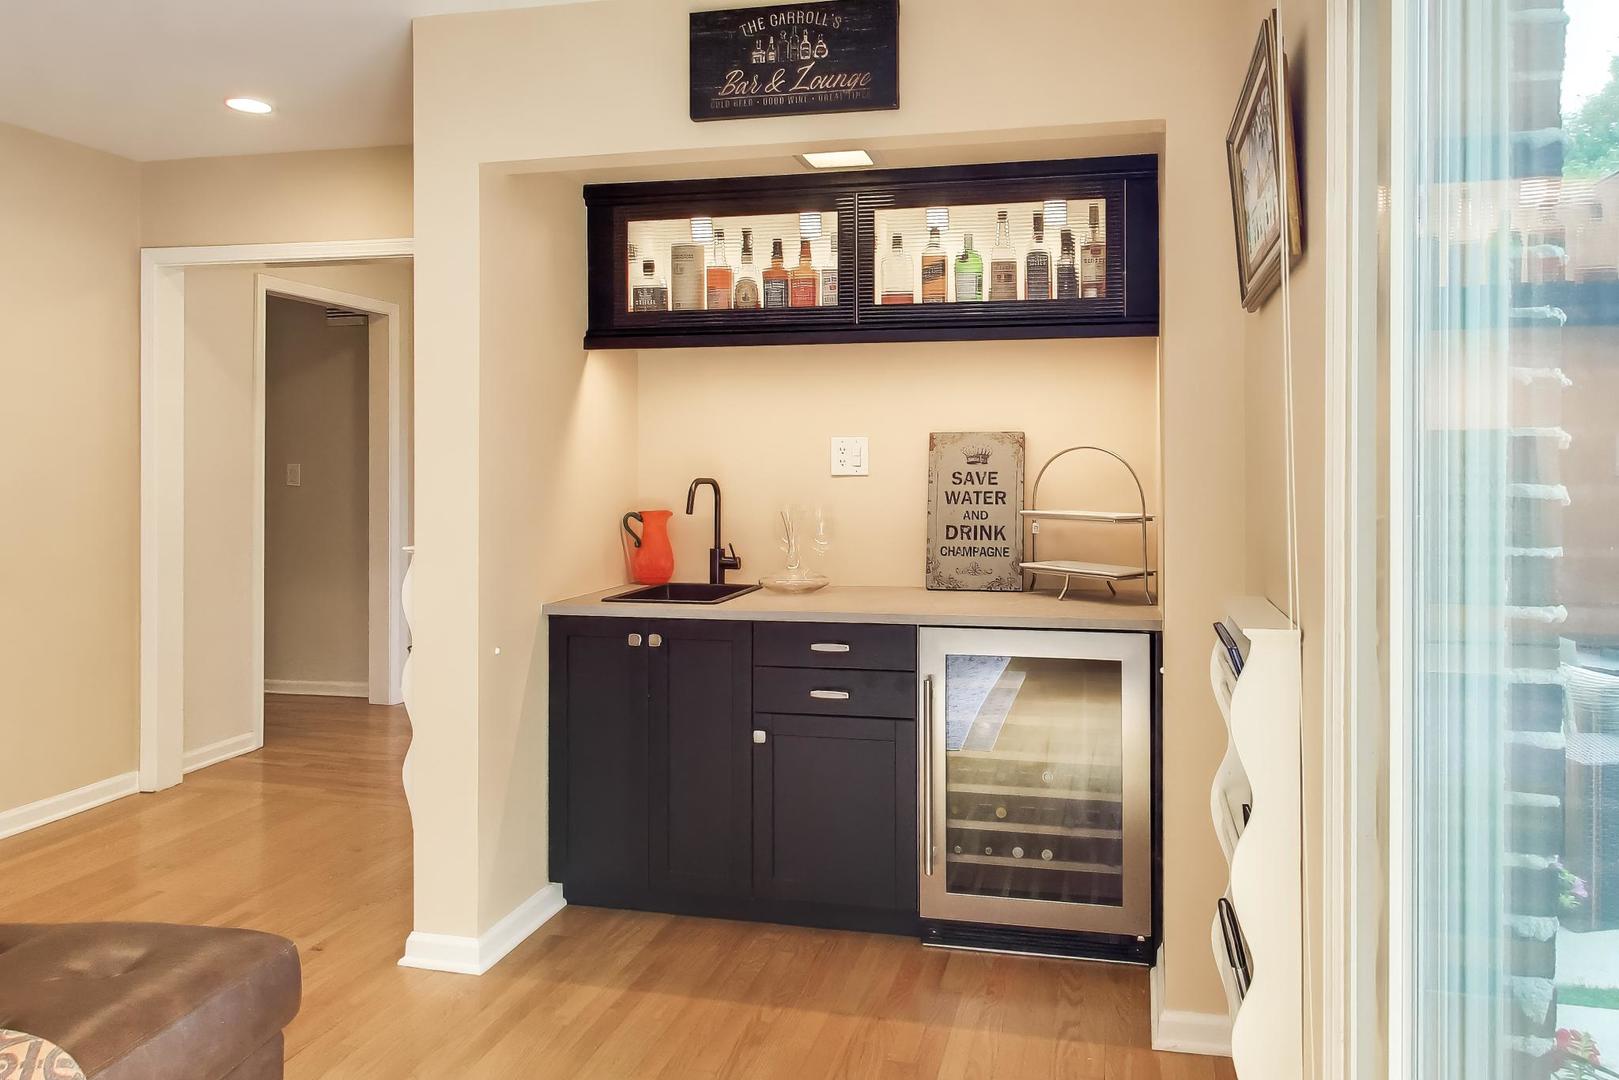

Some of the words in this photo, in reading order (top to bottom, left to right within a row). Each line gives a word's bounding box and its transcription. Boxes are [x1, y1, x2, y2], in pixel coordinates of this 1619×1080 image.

[739, 17, 765, 37] THE
[718, 69, 762, 96] Bar
[764, 68, 785, 94] &
[789, 61, 872, 93] Lounge
[951, 471, 998, 485] SAVE
[944, 490, 1007, 505] WATER
[963, 510, 989, 520] AND
[945, 525, 1006, 541] DRINK
[940, 546, 1010, 557] CHAMPAGNE
